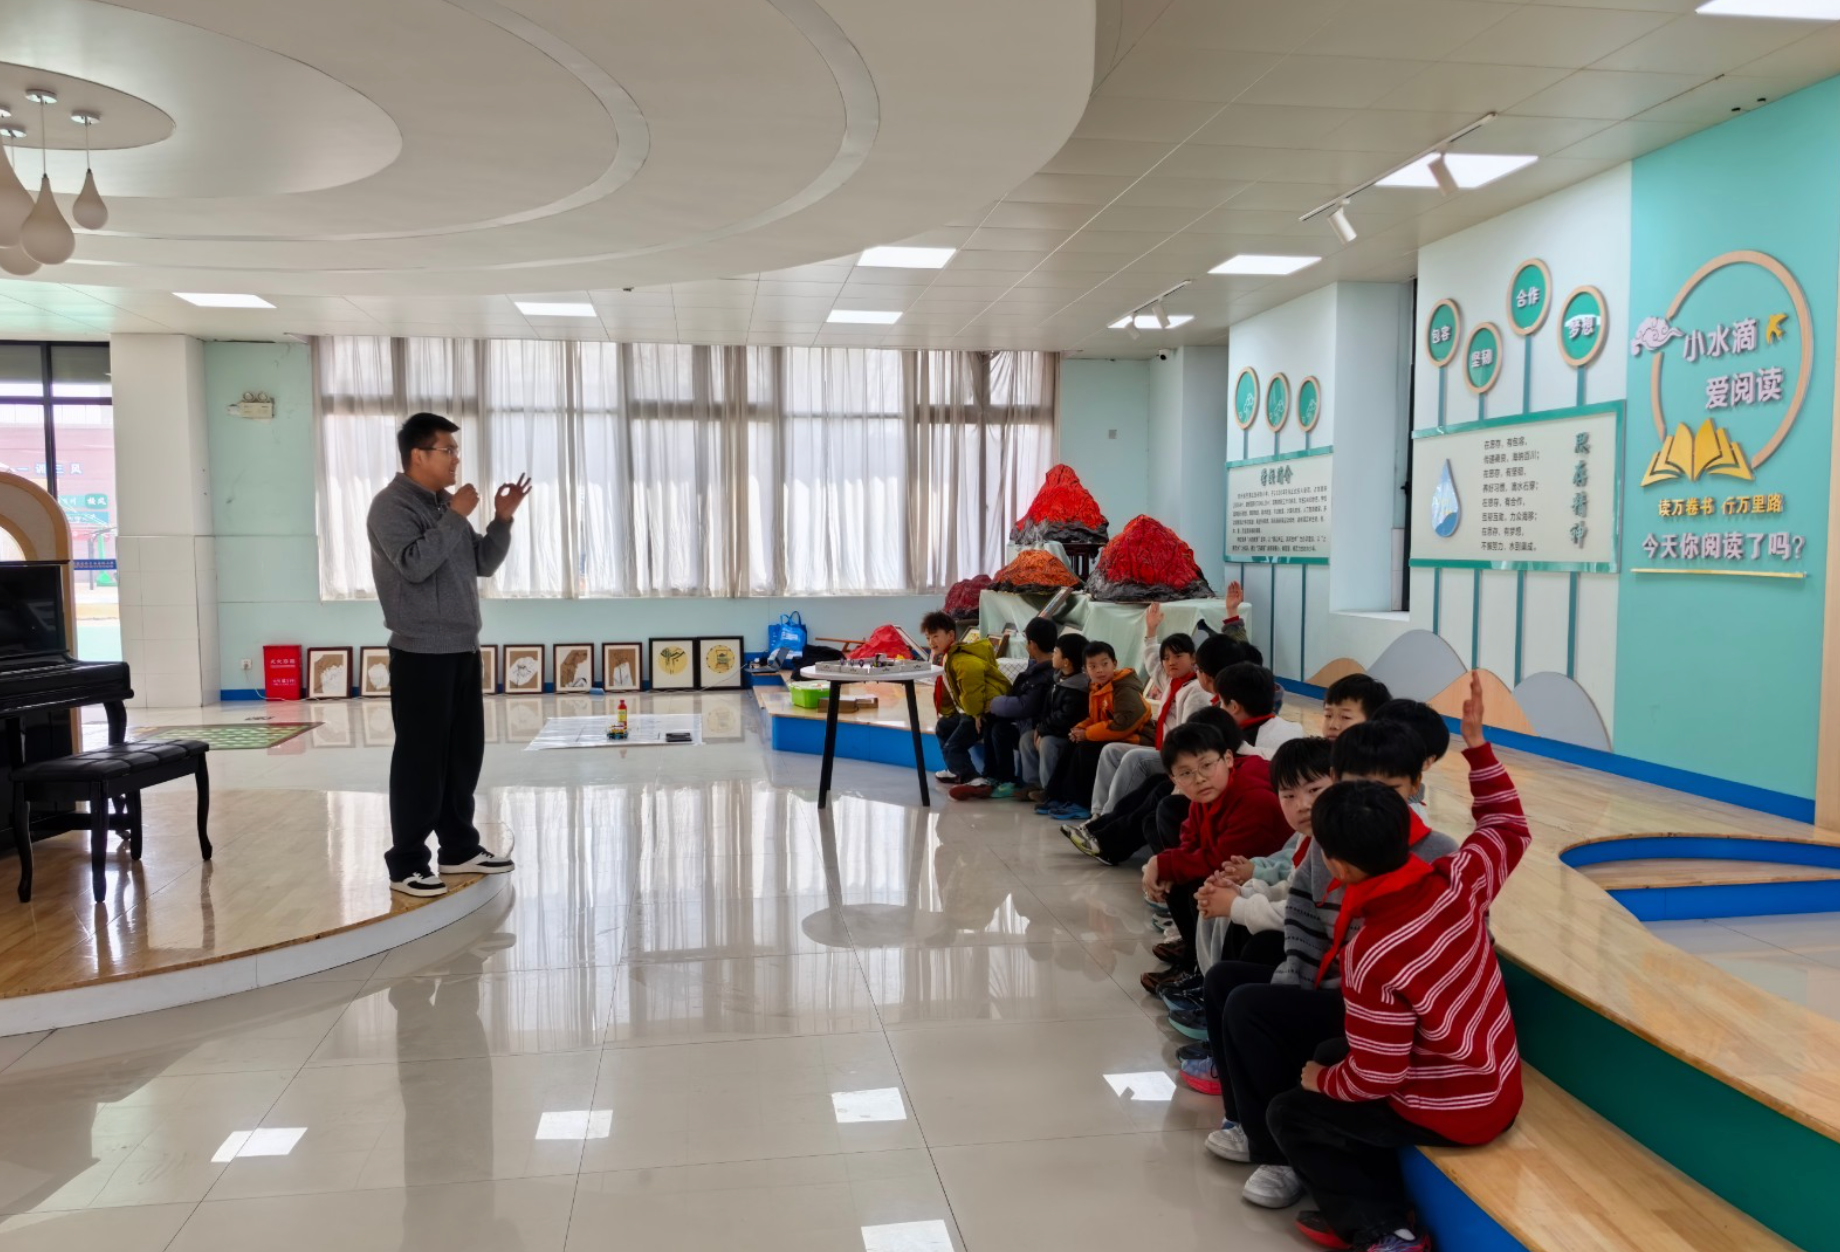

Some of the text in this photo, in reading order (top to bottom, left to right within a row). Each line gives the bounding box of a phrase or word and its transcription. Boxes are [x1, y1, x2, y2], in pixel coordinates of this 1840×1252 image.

[1516, 287, 1540, 307] 合作
[1569, 317, 1595, 339] 梦想
[1683, 318, 1757, 362] 小水滴
[1706, 367, 1782, 409] 爱阅读
[1658, 493, 1783, 516] 读万卷书 行万里路
